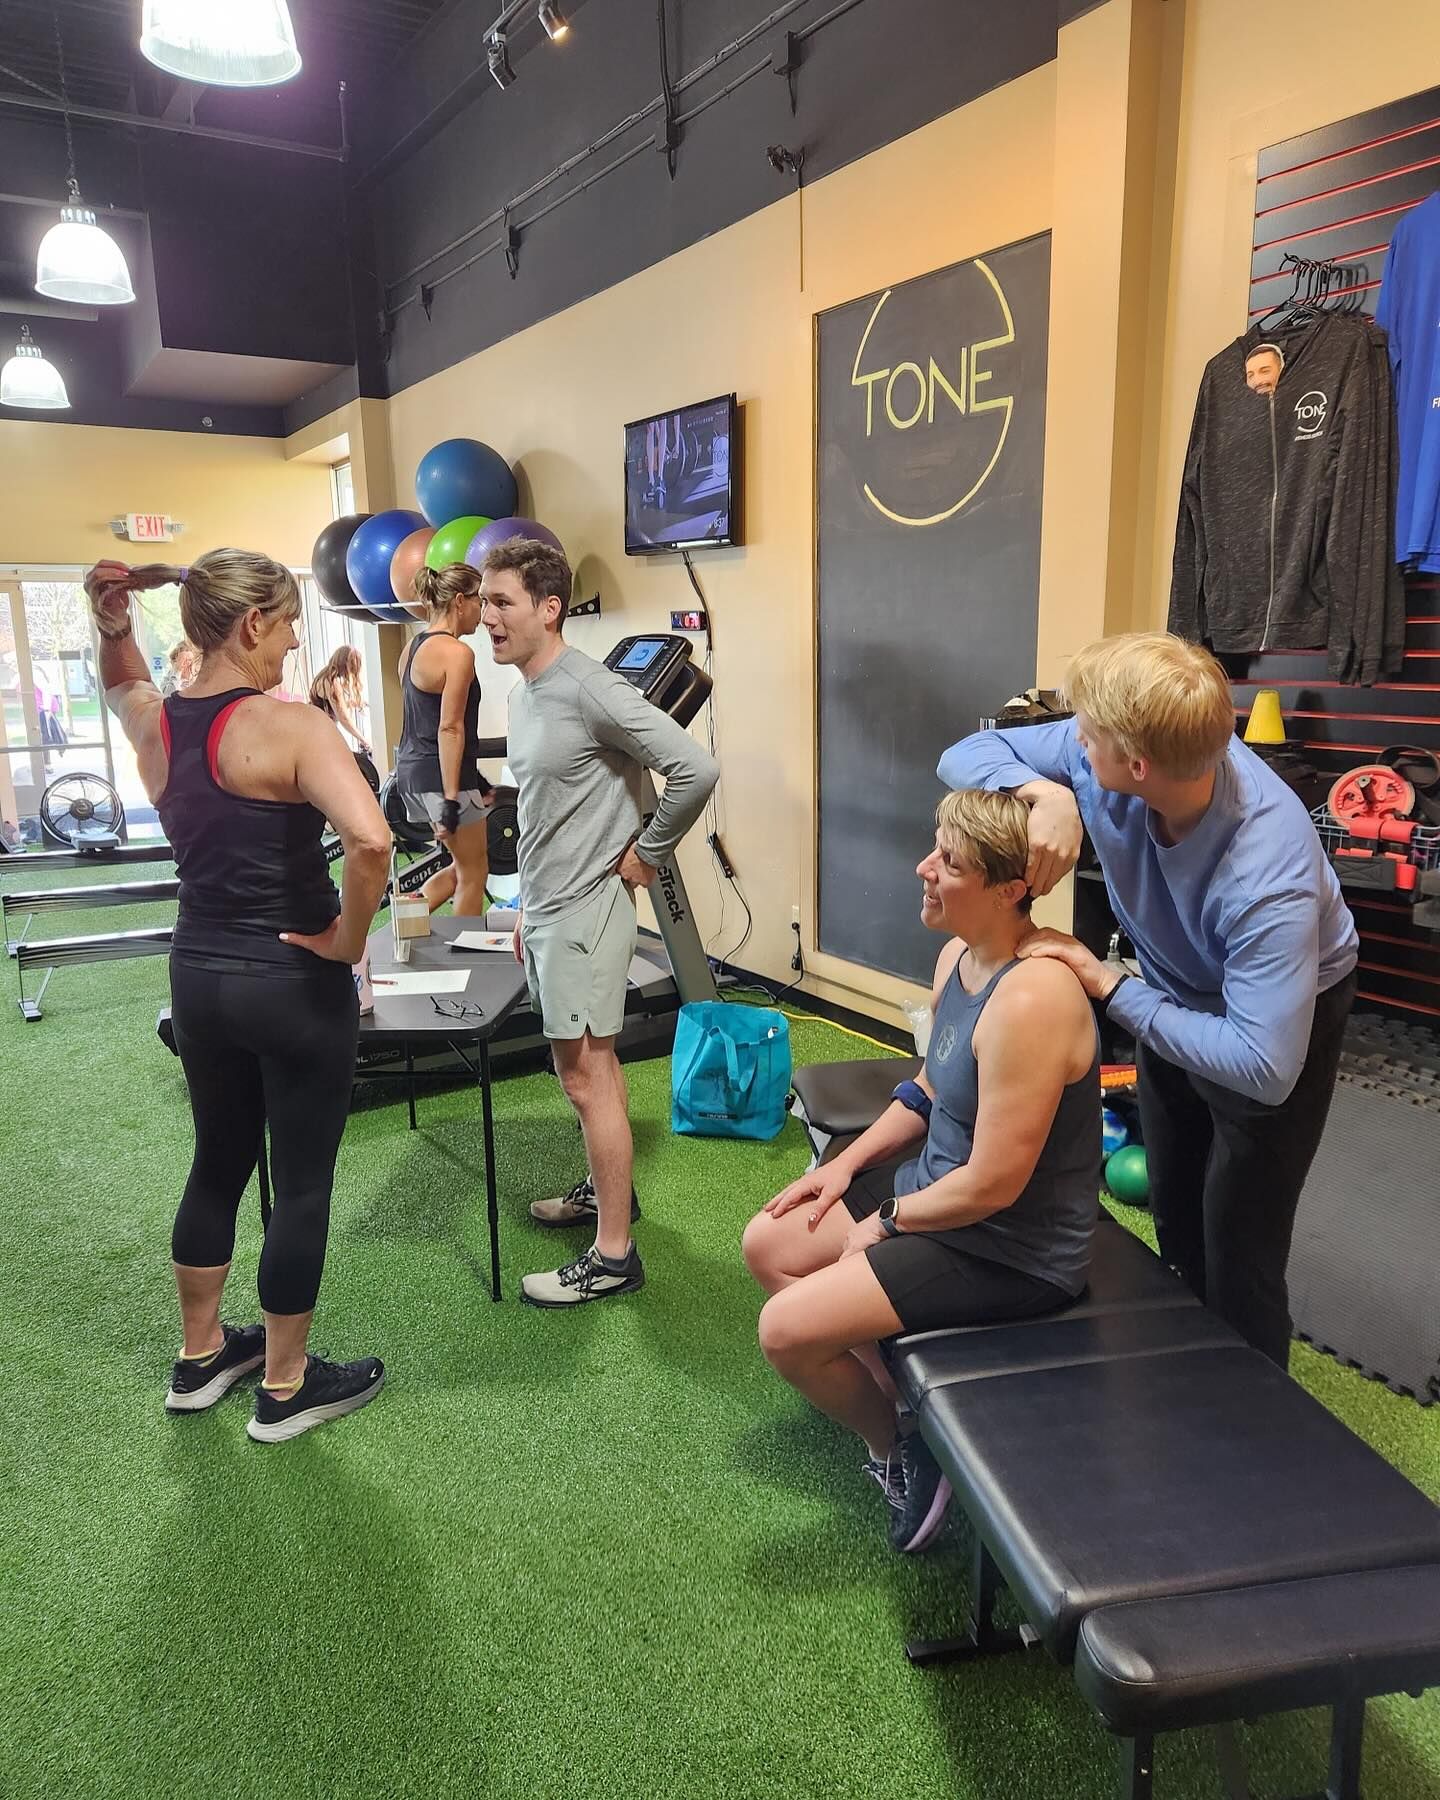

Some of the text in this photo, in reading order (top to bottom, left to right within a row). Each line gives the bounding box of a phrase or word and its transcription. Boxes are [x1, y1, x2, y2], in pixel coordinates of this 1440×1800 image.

[852, 333, 1014, 437] TONE
[1294, 401, 1327, 420] TONE
[135, 515, 165, 537] EXIT
